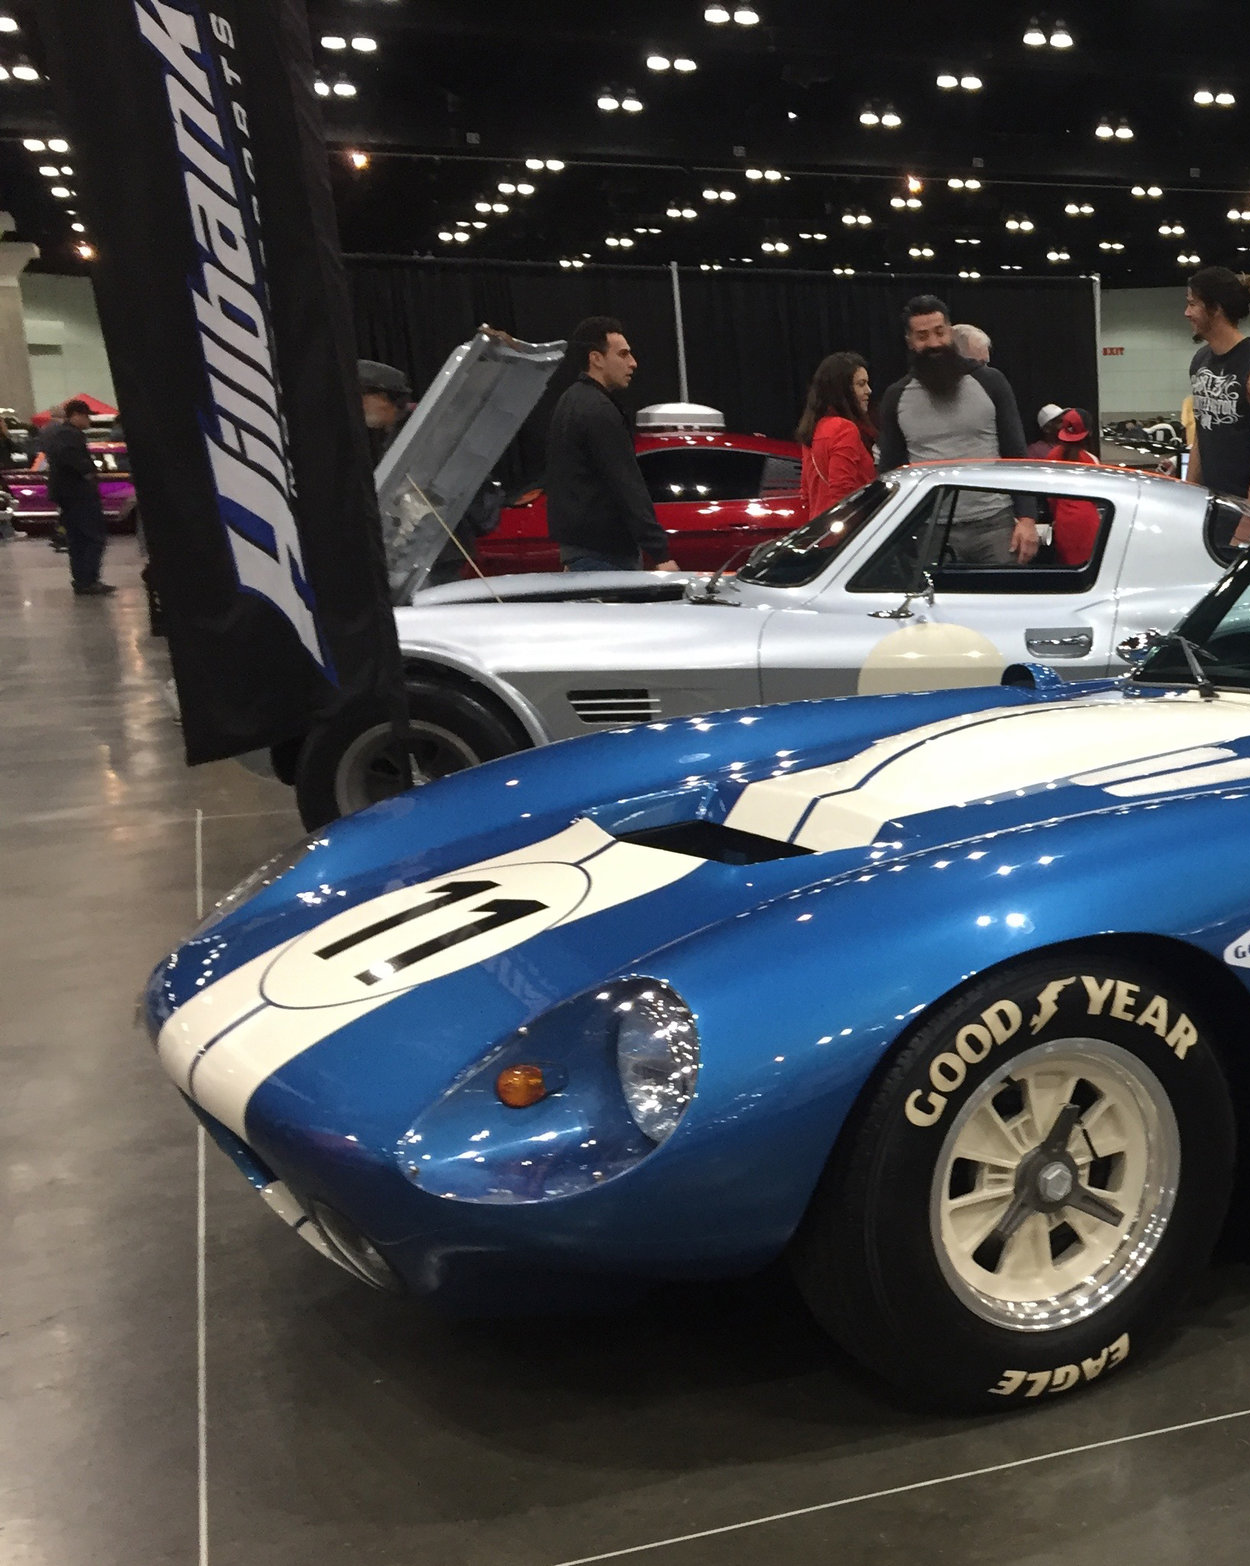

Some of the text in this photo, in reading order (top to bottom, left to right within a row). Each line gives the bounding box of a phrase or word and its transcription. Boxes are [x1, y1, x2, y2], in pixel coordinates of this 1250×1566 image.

[314, 880, 551, 987] 11
[904, 975, 1199, 1128] GOOD YEAR
[987, 1332, 1131, 1398] EAGLE
